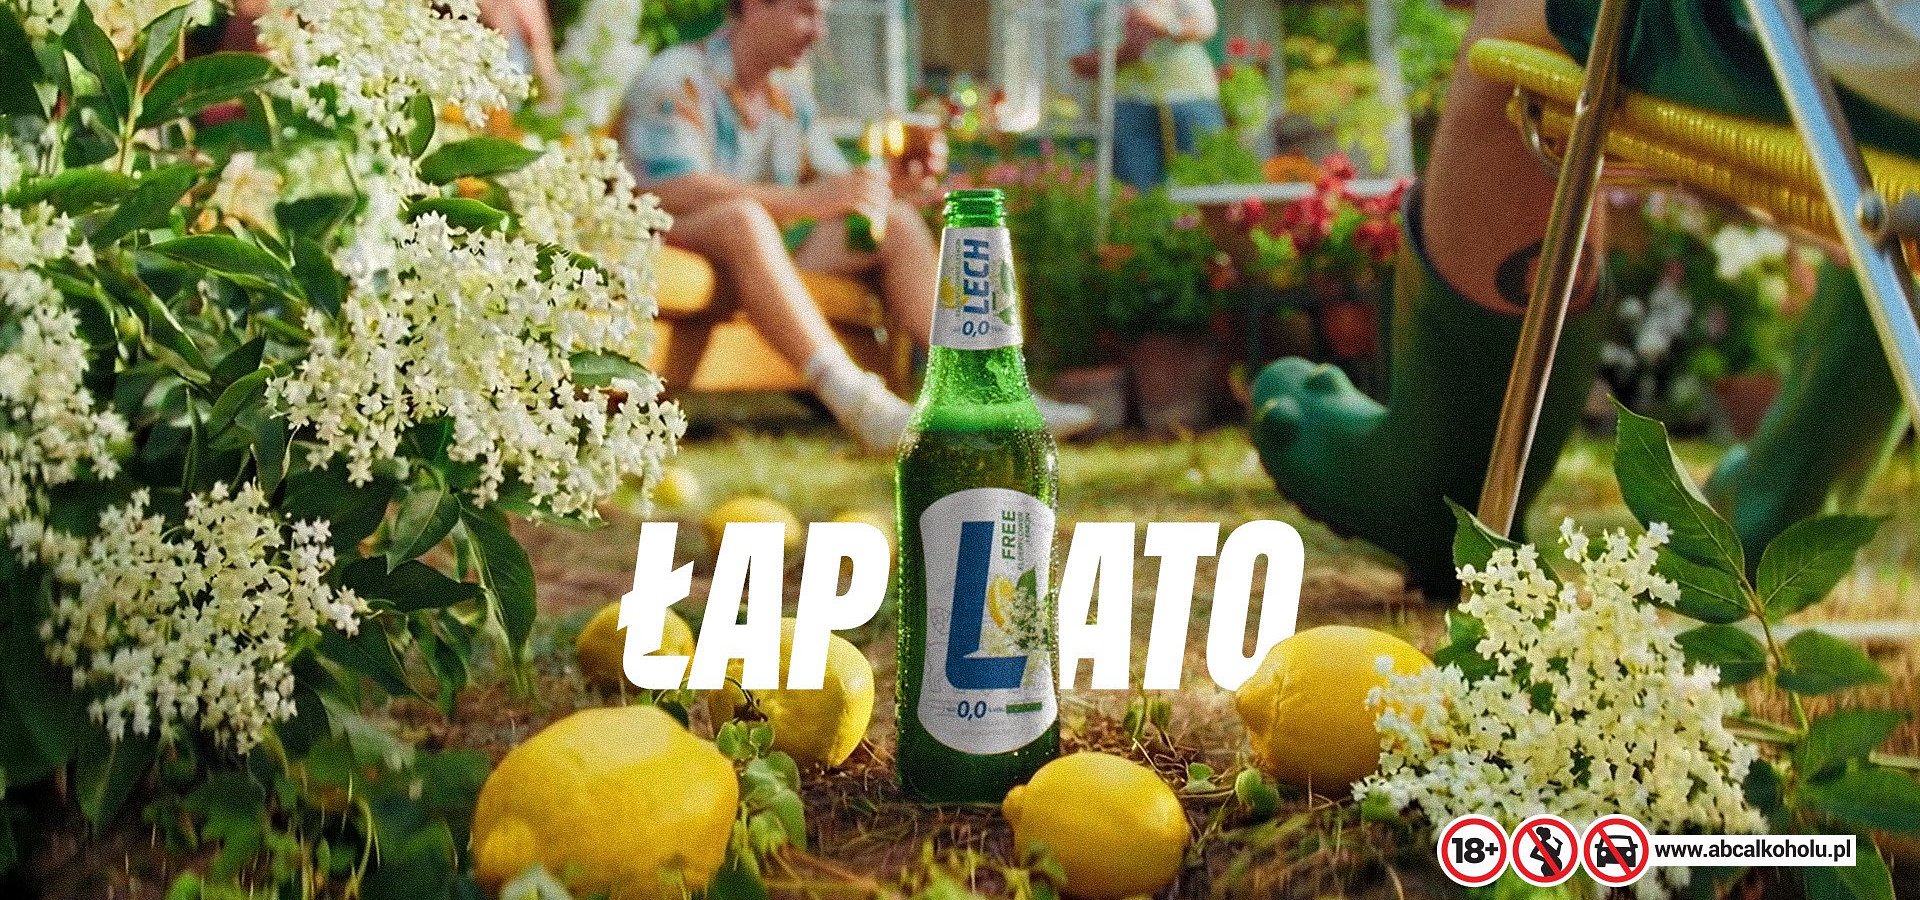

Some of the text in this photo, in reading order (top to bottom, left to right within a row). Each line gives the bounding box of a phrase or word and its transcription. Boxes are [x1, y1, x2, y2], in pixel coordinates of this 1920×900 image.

[963, 239, 990, 315] LECH
[962, 320, 990, 338] 0,0
[1002, 510, 1016, 560] FREE
[957, 700, 987, 720] 0,0
